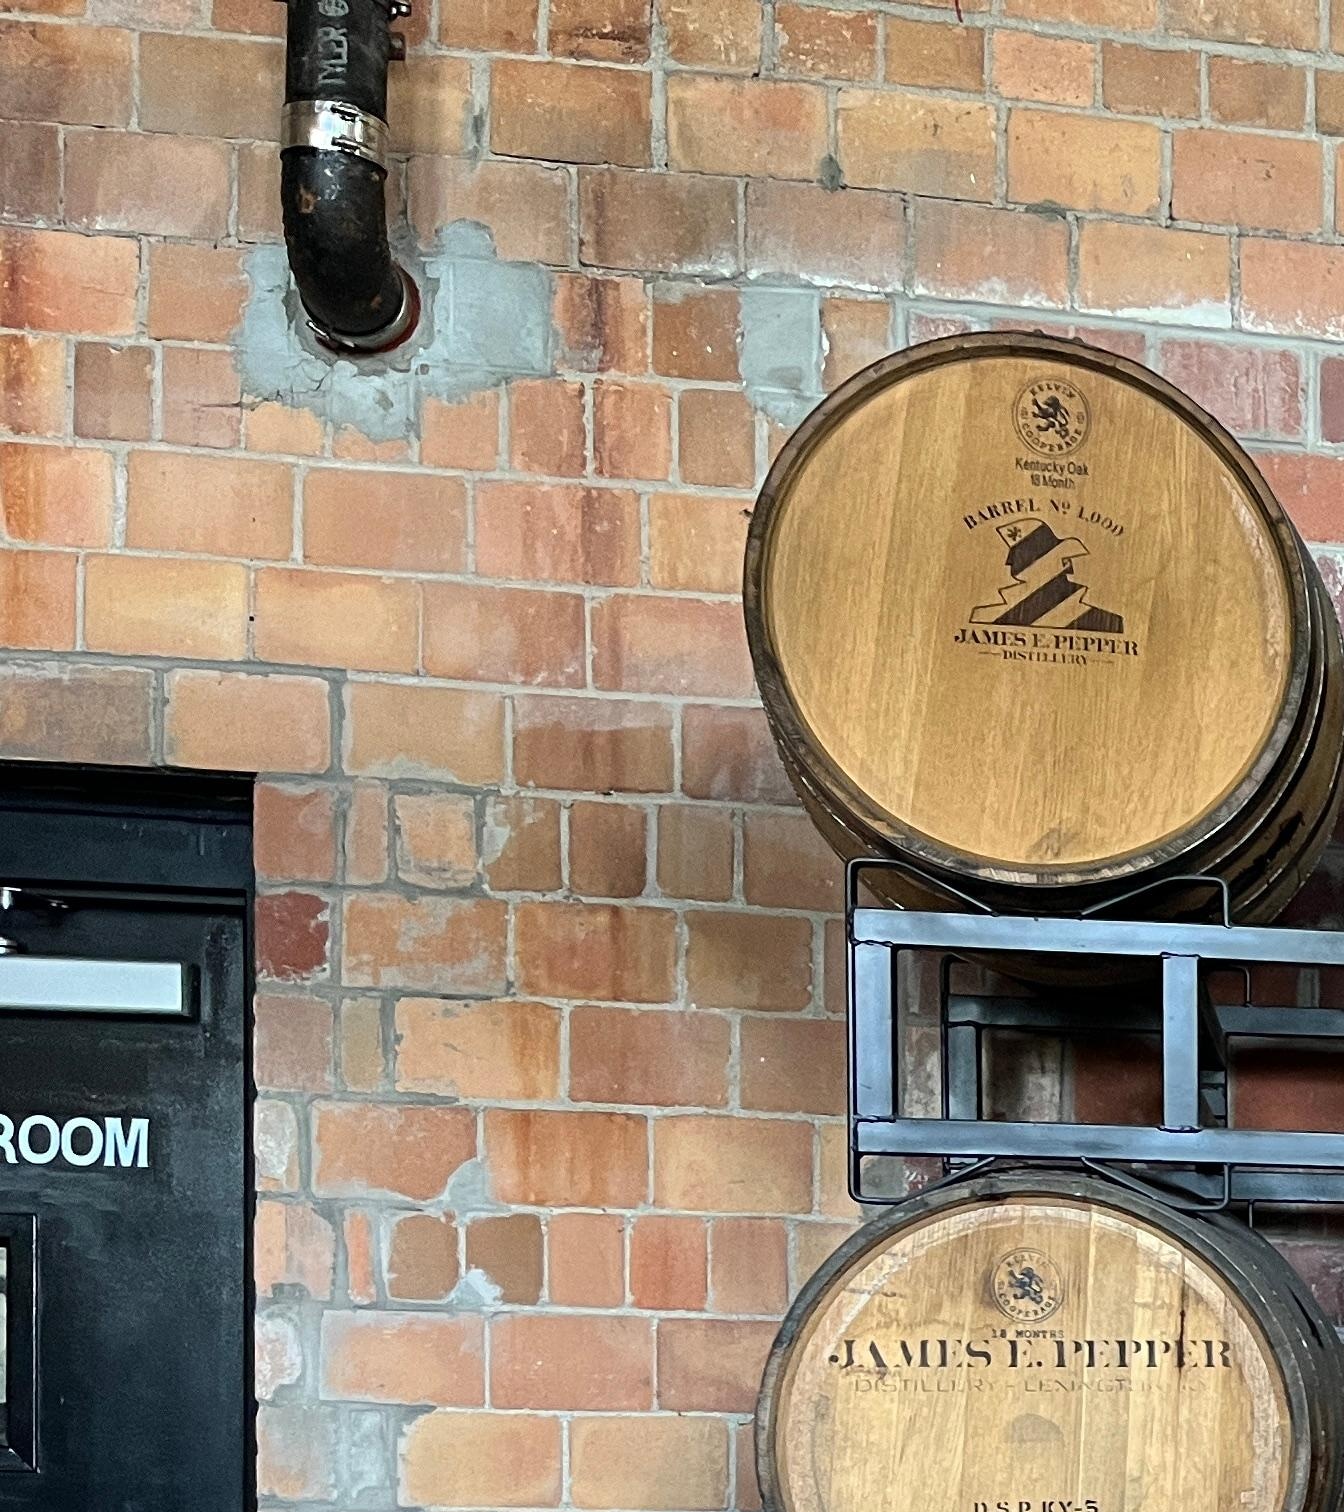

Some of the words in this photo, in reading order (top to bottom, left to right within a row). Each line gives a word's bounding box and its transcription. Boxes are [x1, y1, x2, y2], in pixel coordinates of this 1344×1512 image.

[1016, 458, 1064, 475] Kentucky
[1068, 461, 1089, 476] Oak
[963, 498, 1040, 530] BARREL
[954, 629, 1026, 647] JAMES
[1053, 635, 1138, 656] PEPPER
[1004, 650, 1088, 665] DISTILLERY
[828, 1338, 992, 1369] JAMES
[1056, 1338, 1232, 1369] PEPPER
